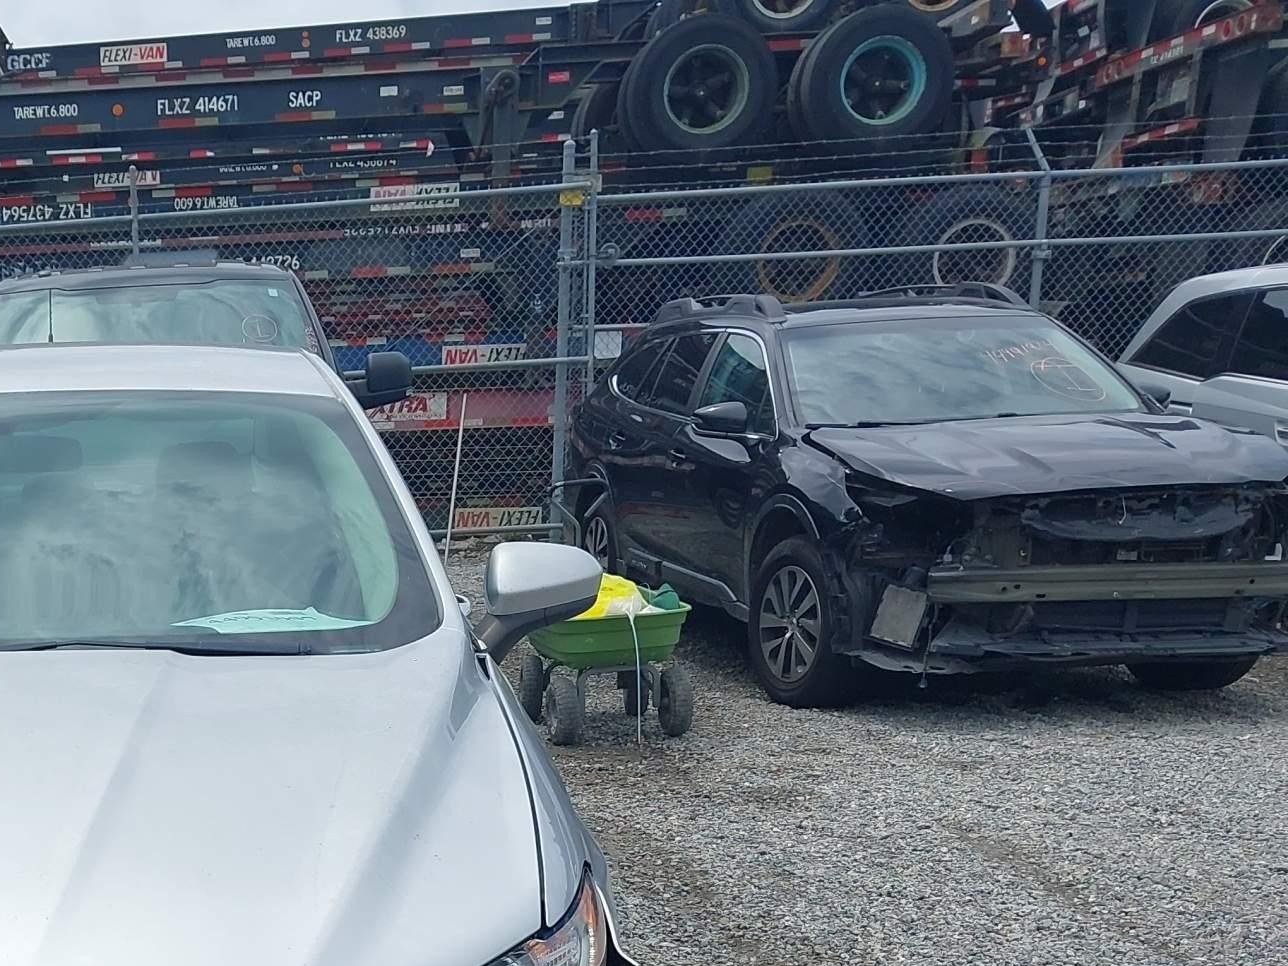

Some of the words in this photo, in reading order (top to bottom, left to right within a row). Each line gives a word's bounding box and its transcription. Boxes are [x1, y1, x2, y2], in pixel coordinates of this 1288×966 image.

[336, 29, 362, 42] FLXZ
[366, 25, 406, 40] 438369
[102, 45, 165, 63] FLEXI-VAN
[157, 98, 190, 115] FLXZ
[195, 95, 238, 113] 414671
[288, 91, 321, 108] SACP
[2, 204, 53, 222] 437564
[59, 202, 91, 219] FLXZ
[455, 510, 540, 529] FLEXI-VAN
